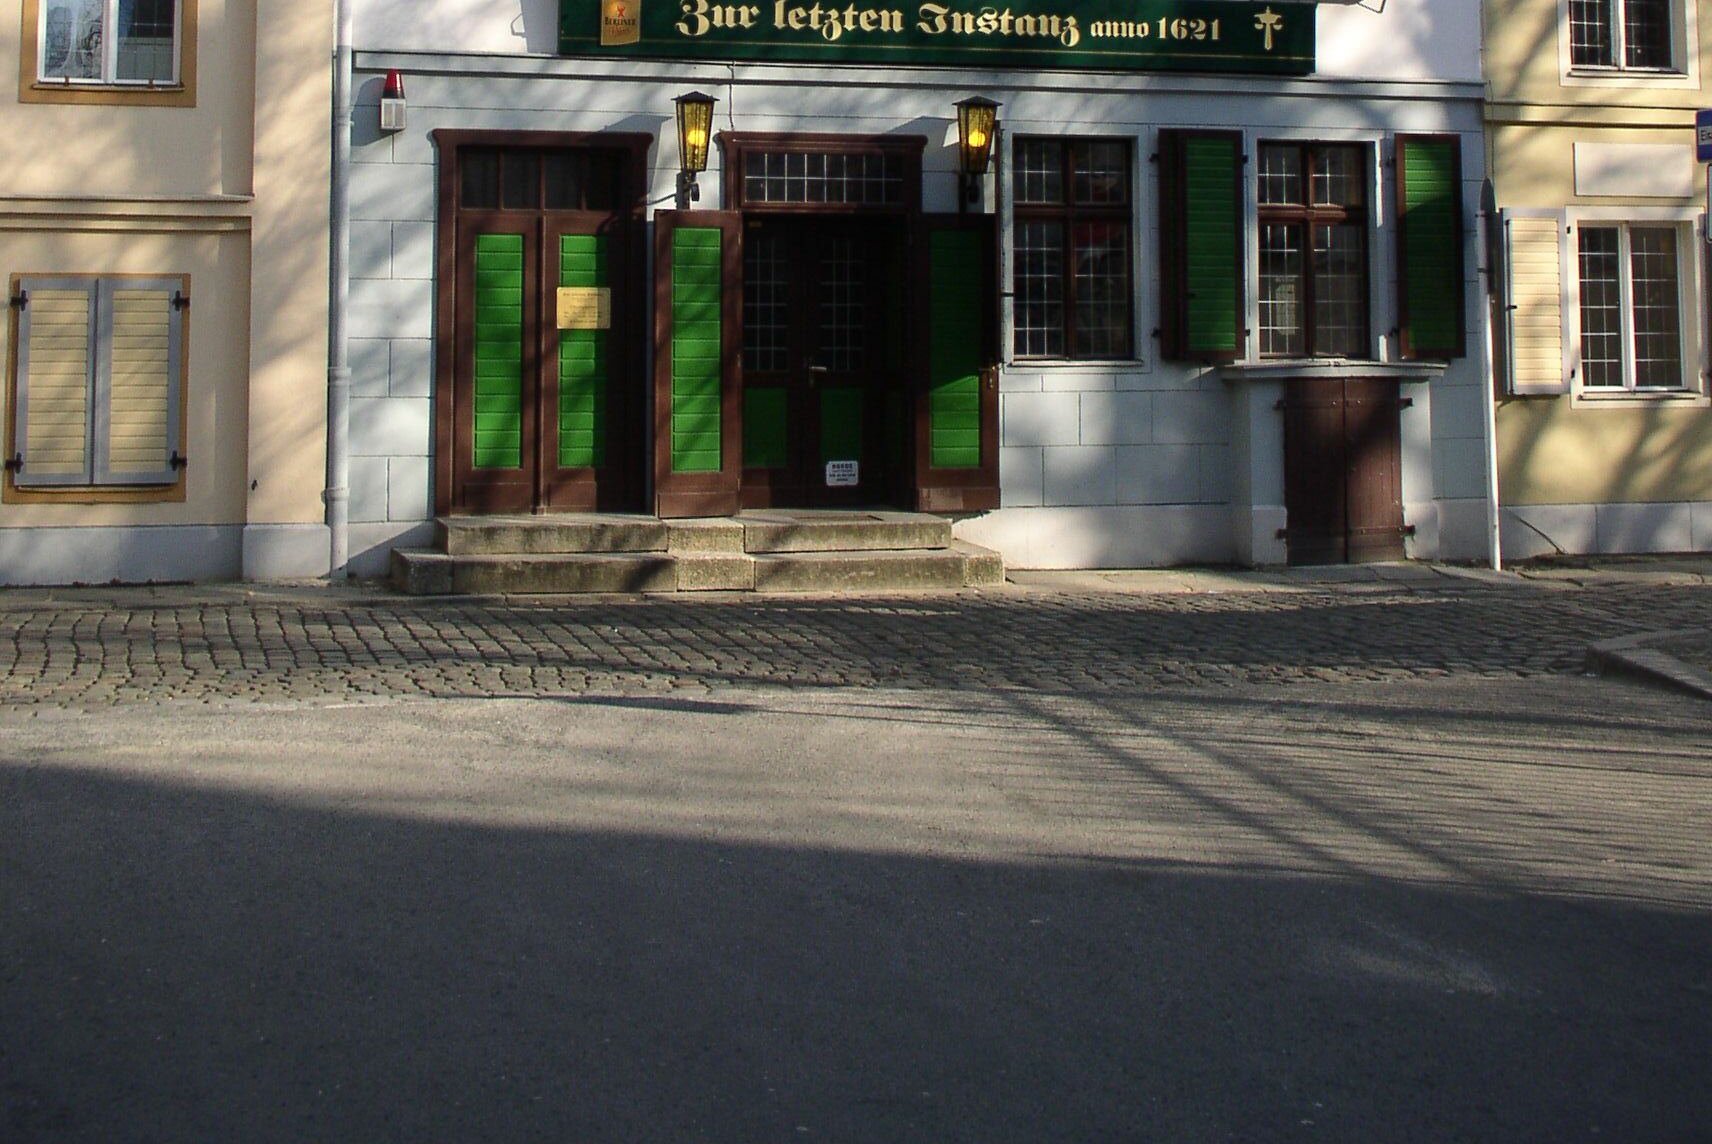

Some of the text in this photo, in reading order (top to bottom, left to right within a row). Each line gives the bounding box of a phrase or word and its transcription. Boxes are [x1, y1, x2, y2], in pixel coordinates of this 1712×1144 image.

[916, 2, 1080, 47] Instanz
[1089, 19, 1150, 38] anno
[1156, 16, 1221, 40] 1621
